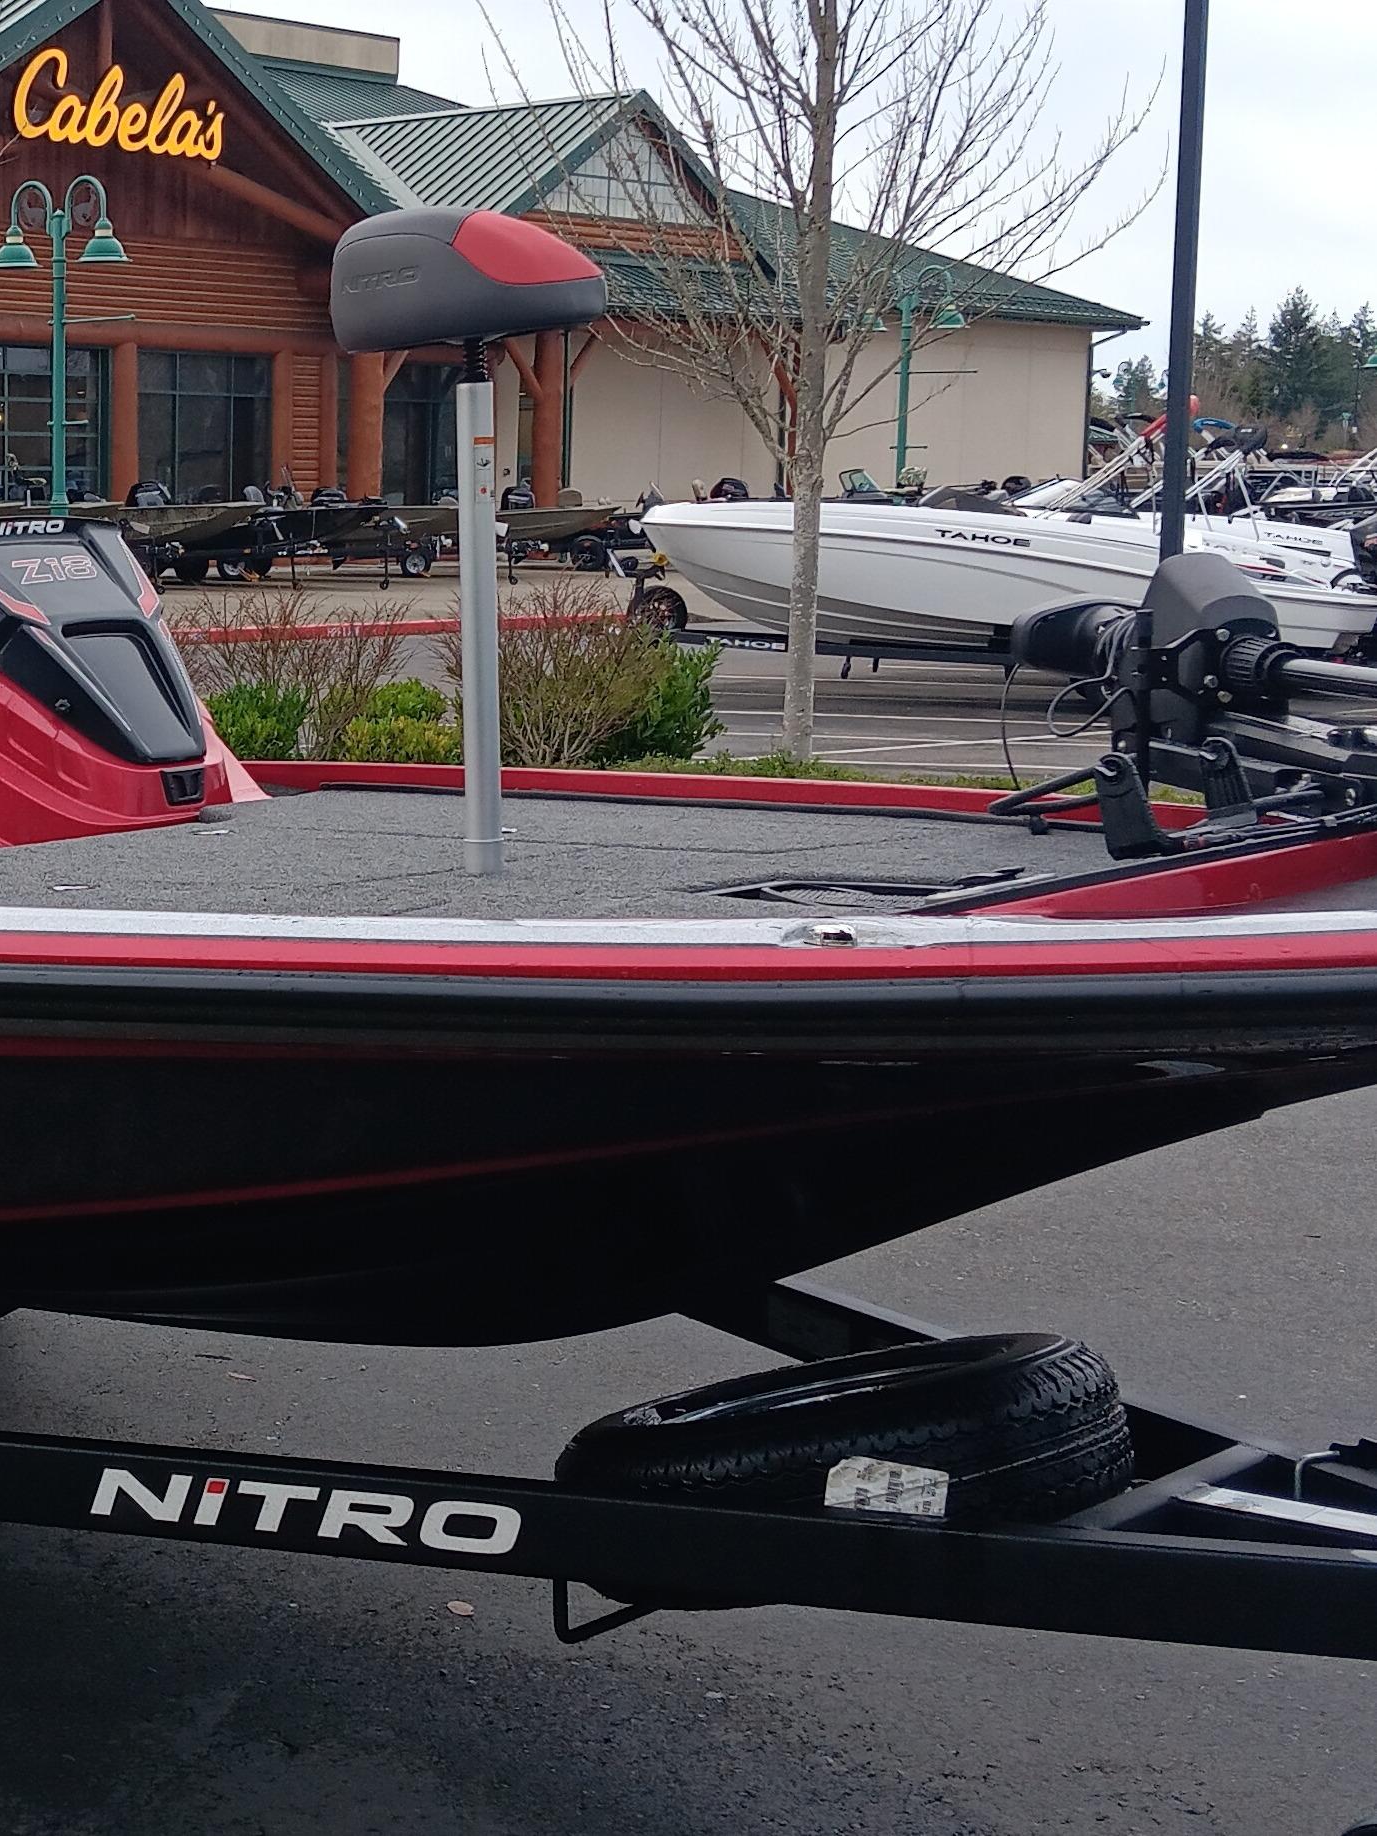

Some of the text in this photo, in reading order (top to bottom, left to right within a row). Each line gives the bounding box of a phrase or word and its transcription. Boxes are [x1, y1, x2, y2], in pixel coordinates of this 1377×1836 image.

[14, 48, 224, 160] Cabela's
[935, 528, 1032, 548] TAHOE
[1263, 531, 1325, 546] TAHOE
[11, 555, 98, 584] Z18
